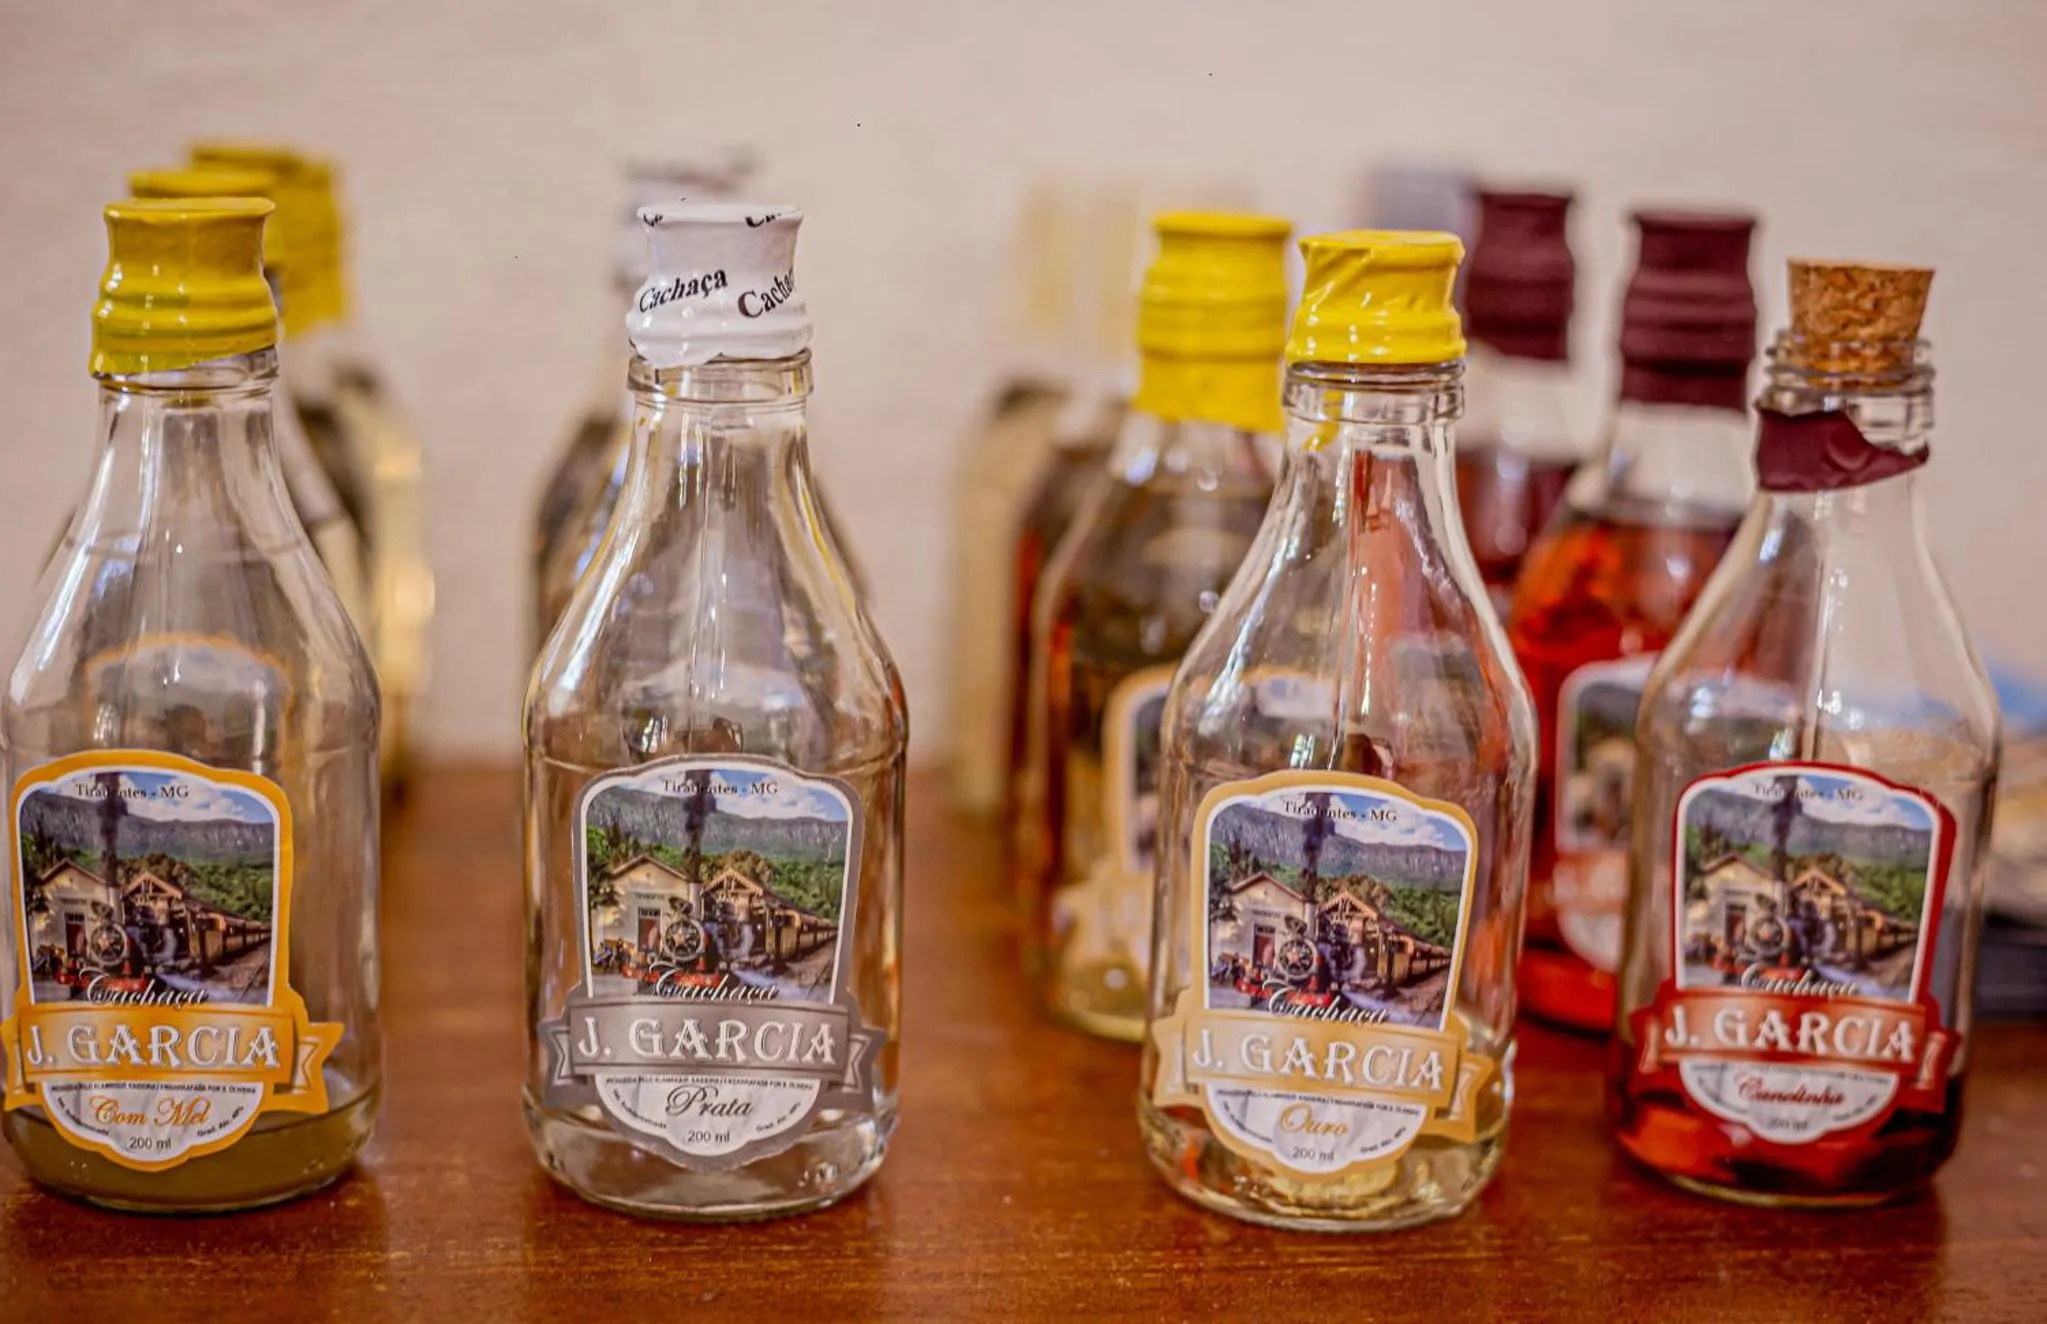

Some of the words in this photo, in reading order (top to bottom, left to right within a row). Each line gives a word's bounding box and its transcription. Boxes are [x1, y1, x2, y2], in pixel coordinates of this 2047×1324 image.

[640, 268, 728, 313] Cachaça
[738, 267, 796, 318] Cacha
[160, 784, 189, 799] MG
[751, 781, 779, 795] MG
[1370, 808, 1398, 821] MG
[79, 966, 209, 1009] Cachaça
[649, 960, 780, 1005] Cachaça
[1262, 979, 1391, 1026] Cachaça
[27, 1025, 56, 1066] J.
[66, 1024, 281, 1069] GARCIA
[578, 1016, 612, 1058] J.
[628, 1017, 838, 1065] GARCIA
[1663, 1004, 1700, 1048] J.
[1713, 1005, 1916, 1063] GARCIA
[1192, 1028, 1225, 1068] J.
[1240, 1033, 1445, 1092] GARCIA
[88, 1094, 148, 1126] Com
[664, 1083, 755, 1118] Prata
[1278, 1102, 1350, 1137] Ouro
[128, 1136, 153, 1149] 200
[156, 1136, 172, 1150] ml
[687, 1130, 712, 1143] 200
[714, 1130, 731, 1144] ml
[1291, 1145, 1316, 1160] 200
[1318, 1149, 1335, 1162] ml
